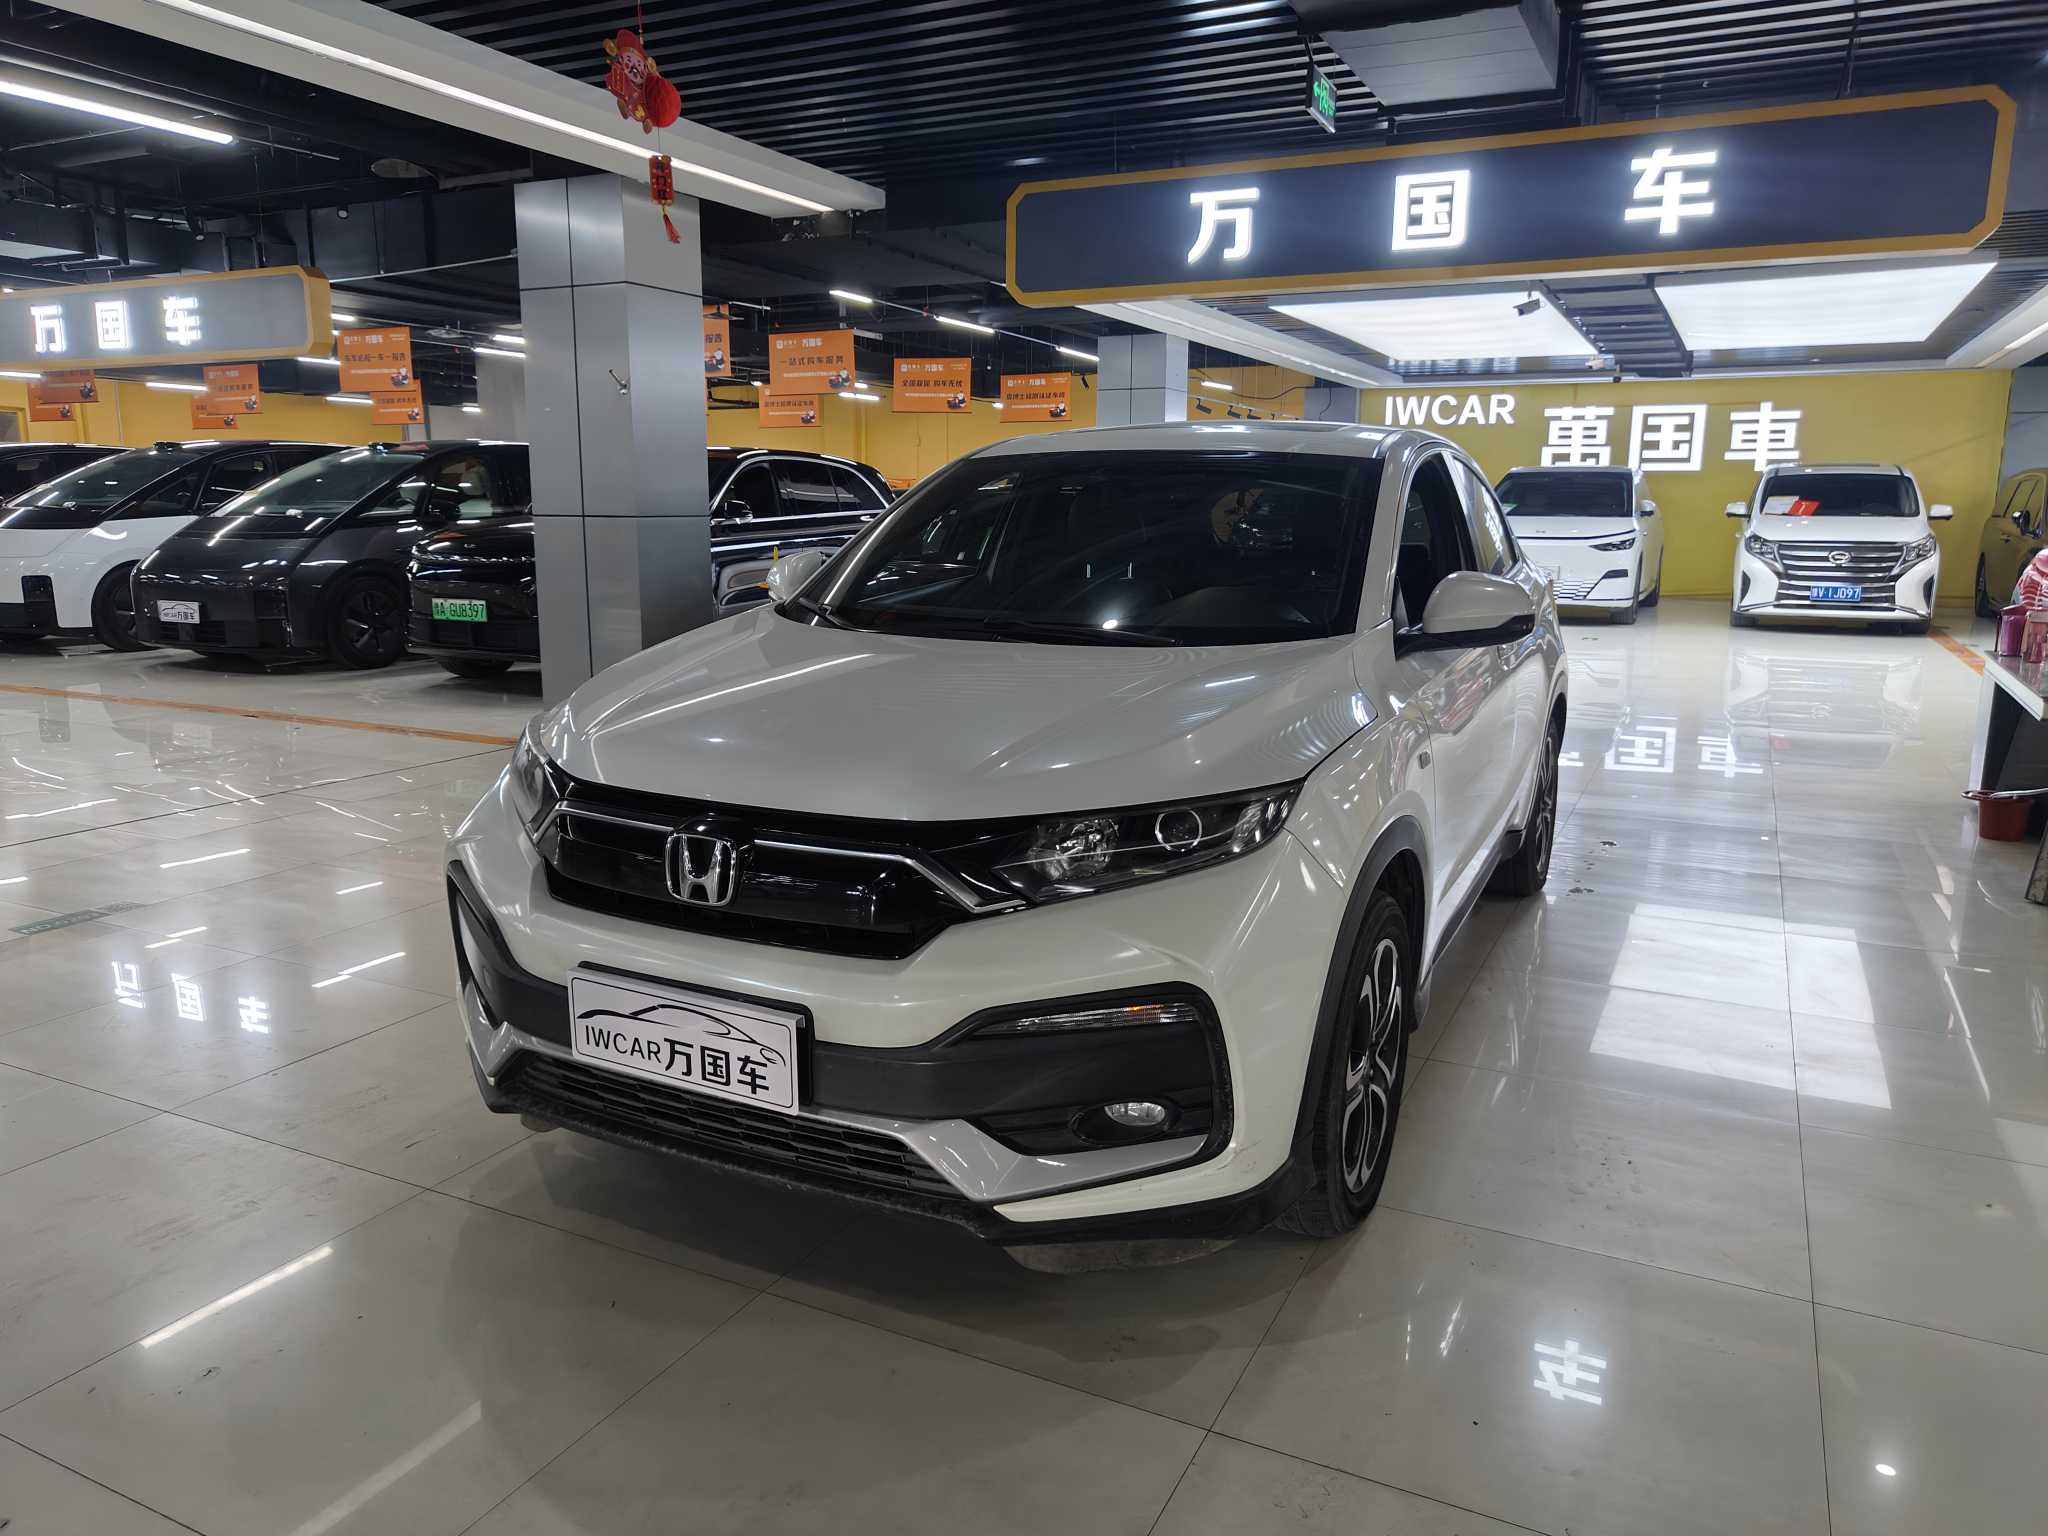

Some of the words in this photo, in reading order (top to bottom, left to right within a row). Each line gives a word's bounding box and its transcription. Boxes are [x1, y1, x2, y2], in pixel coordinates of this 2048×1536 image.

[1187, 147, 1717, 264] 万国车
[30, 296, 201, 353] 万国车
[1384, 394, 1515, 425] IWCAR
